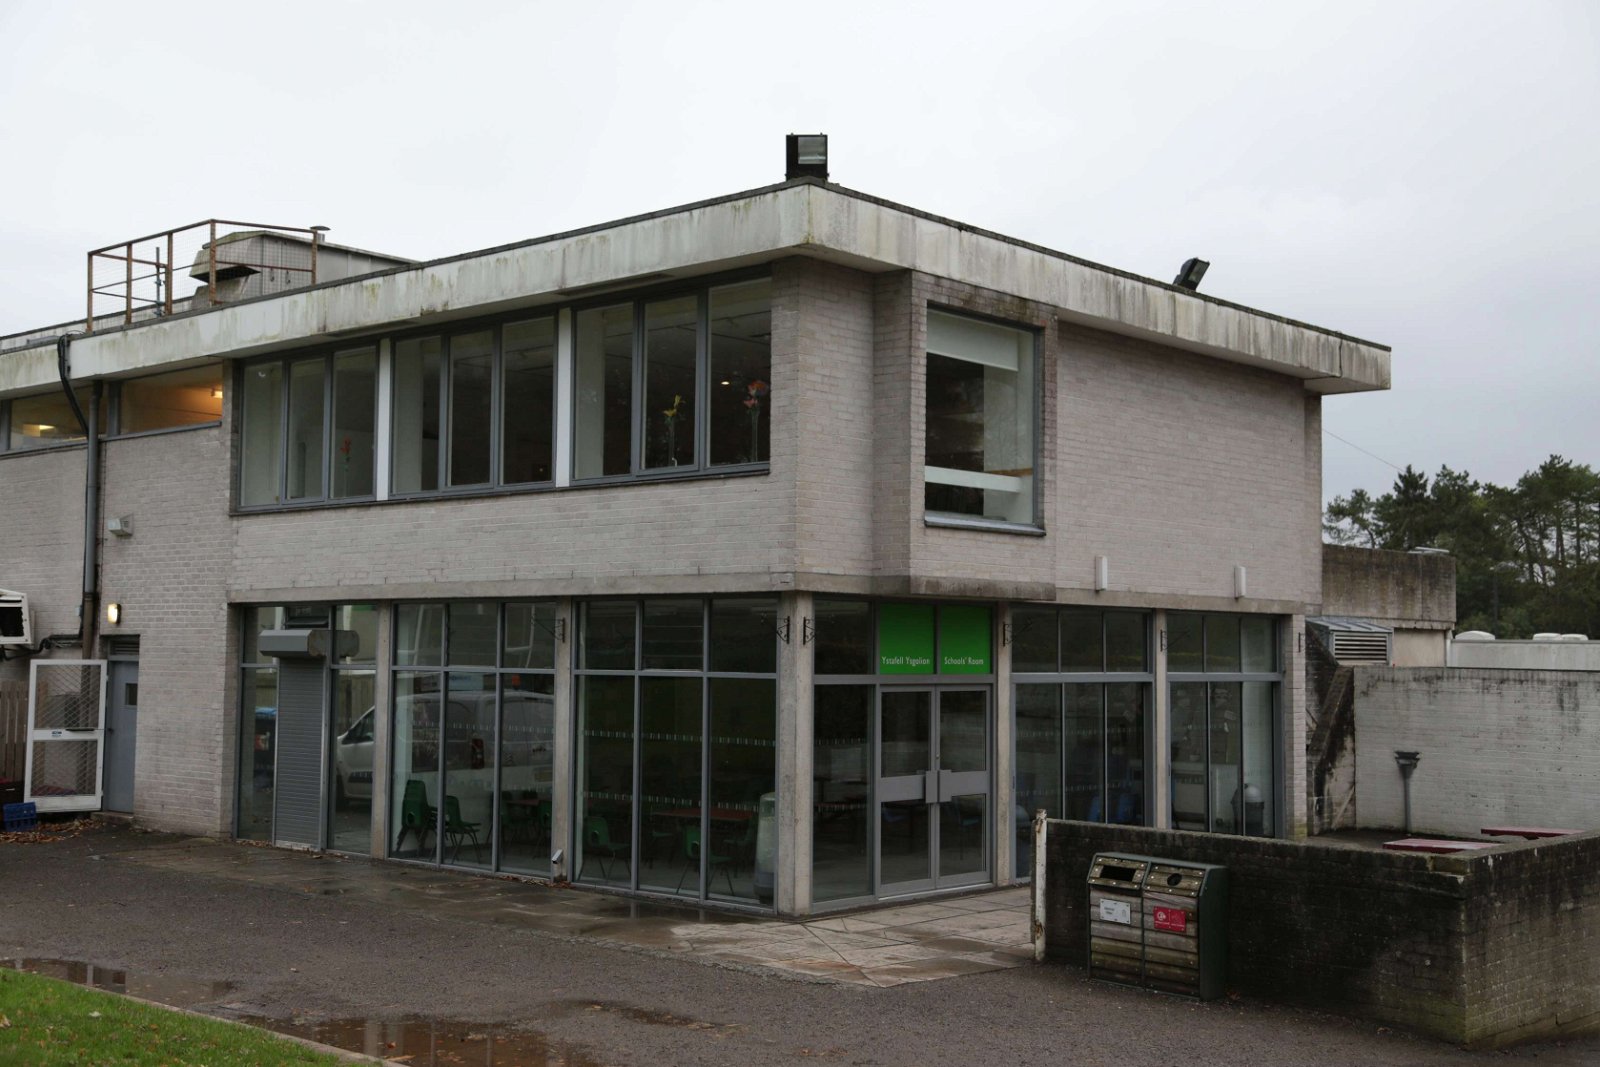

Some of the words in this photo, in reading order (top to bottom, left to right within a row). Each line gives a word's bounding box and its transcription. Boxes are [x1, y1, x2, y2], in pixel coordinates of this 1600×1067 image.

[882, 656, 904, 665] Ystafell
[906, 656, 930, 666] Ysgolion
[968, 657, 984, 665] Room
